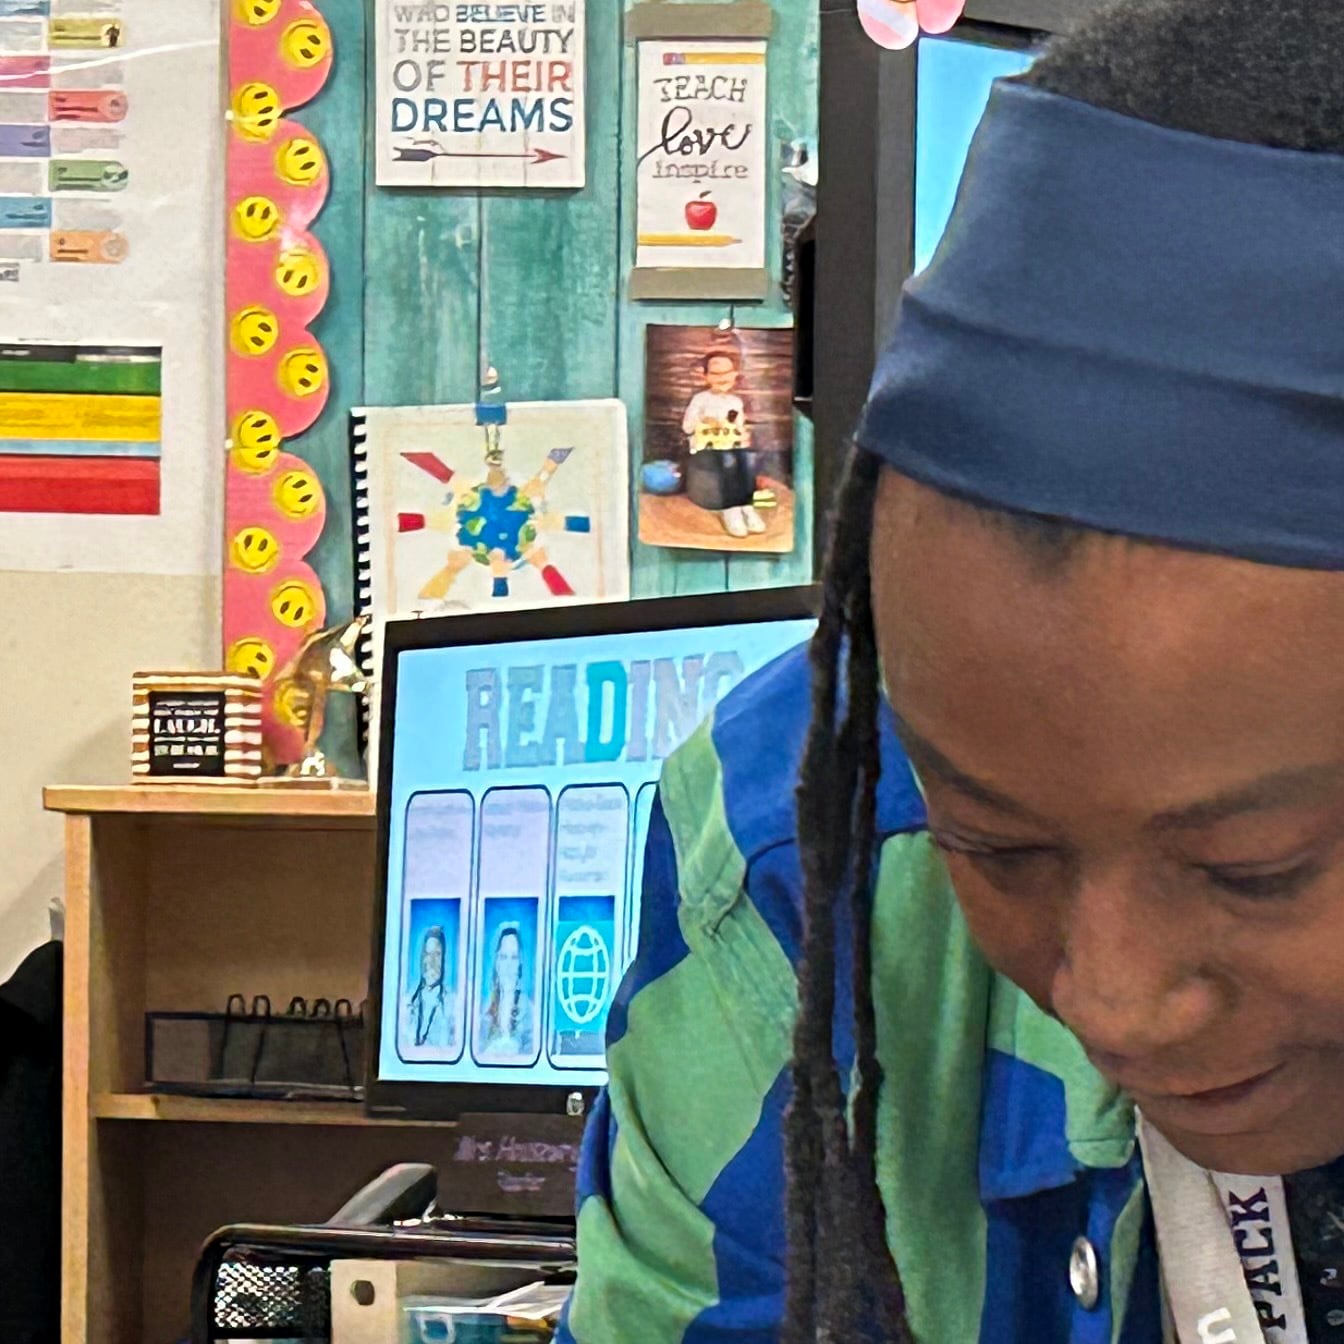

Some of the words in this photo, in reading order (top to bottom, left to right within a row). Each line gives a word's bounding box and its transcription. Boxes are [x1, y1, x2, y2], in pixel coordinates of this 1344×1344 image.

[394, 5, 450, 23] WHO
[456, 5, 546, 23] BELIEVE
[552, 5, 575, 23] IN
[394, 28, 451, 53] THE
[459, 28, 575, 53] BEAUTY
[393, 59, 446, 92] OF
[456, 60, 572, 92] THEIR
[653, 75, 747, 102] TEACH
[392, 97, 574, 132] DREAMS
[646, 106, 752, 156] love
[1229, 1187, 1287, 1330] PACK
